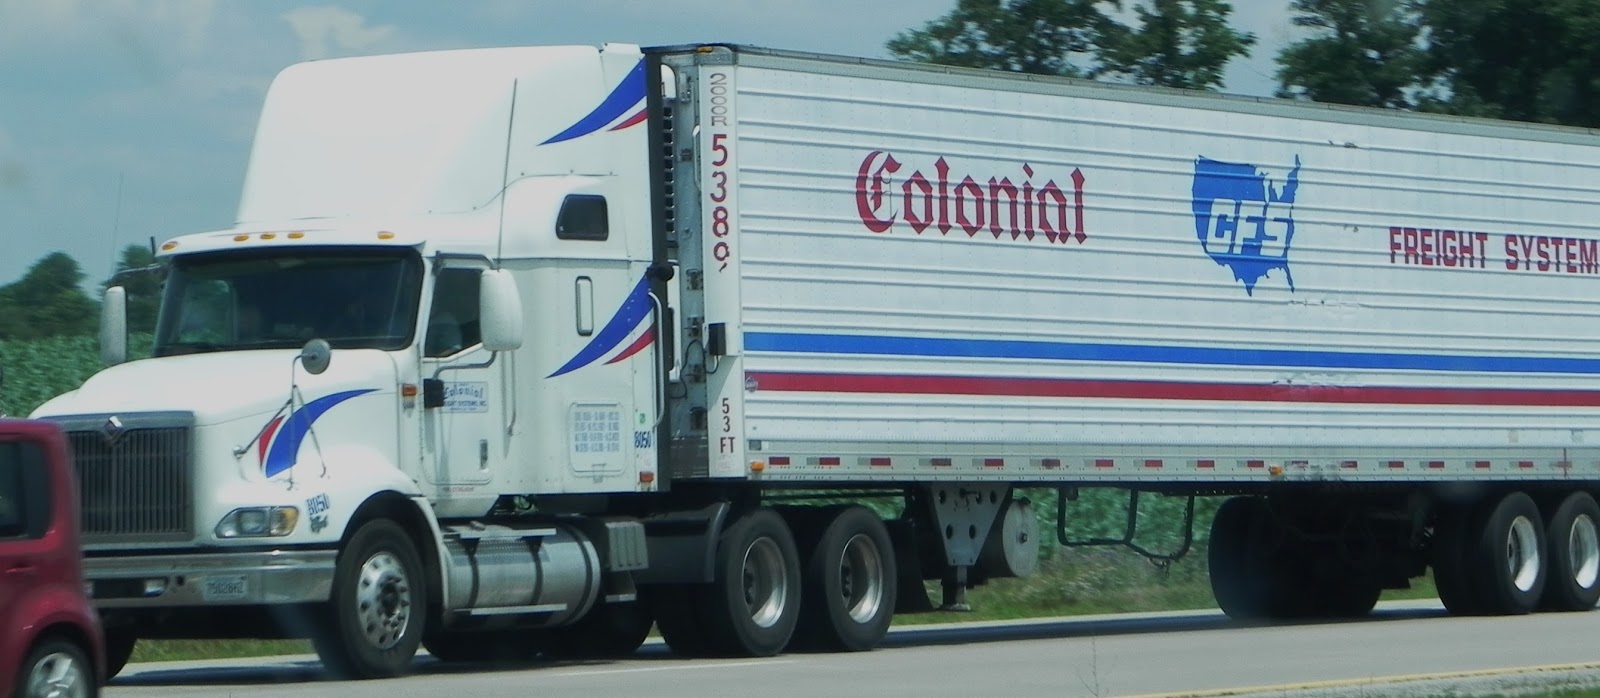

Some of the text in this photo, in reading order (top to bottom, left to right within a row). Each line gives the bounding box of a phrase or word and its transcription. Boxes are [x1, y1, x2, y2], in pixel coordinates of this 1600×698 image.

[709, 72, 728, 127] 2000R
[856, 151, 1088, 245] Colonial
[1206, 198, 1293, 257] CFS
[1389, 226, 1600, 275] FREIGHT SYSTEM
[719, 436, 736, 454] FT
